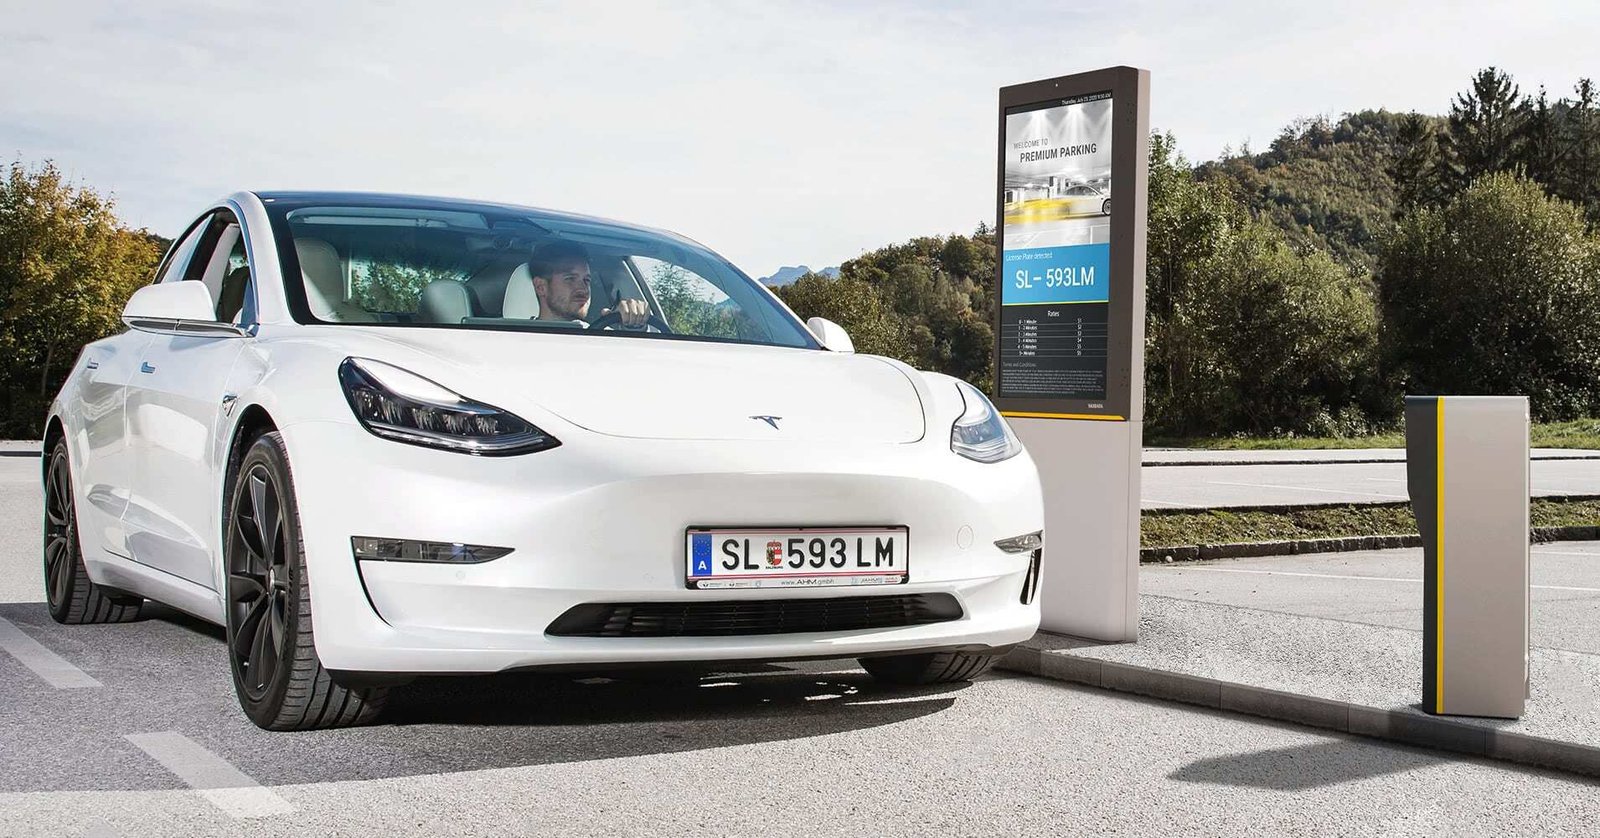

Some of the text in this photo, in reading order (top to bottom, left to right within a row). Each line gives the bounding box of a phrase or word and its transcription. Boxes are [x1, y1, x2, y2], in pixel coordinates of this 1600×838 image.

[1013, 138, 1048, 150] WELCOME TO
[1020, 143, 1097, 163] PREMIUM PARKING
[1046, 266, 1095, 288] 593LM
[722, 536, 894, 570] SL 593 LM
[698, 560, 707, 570] A
